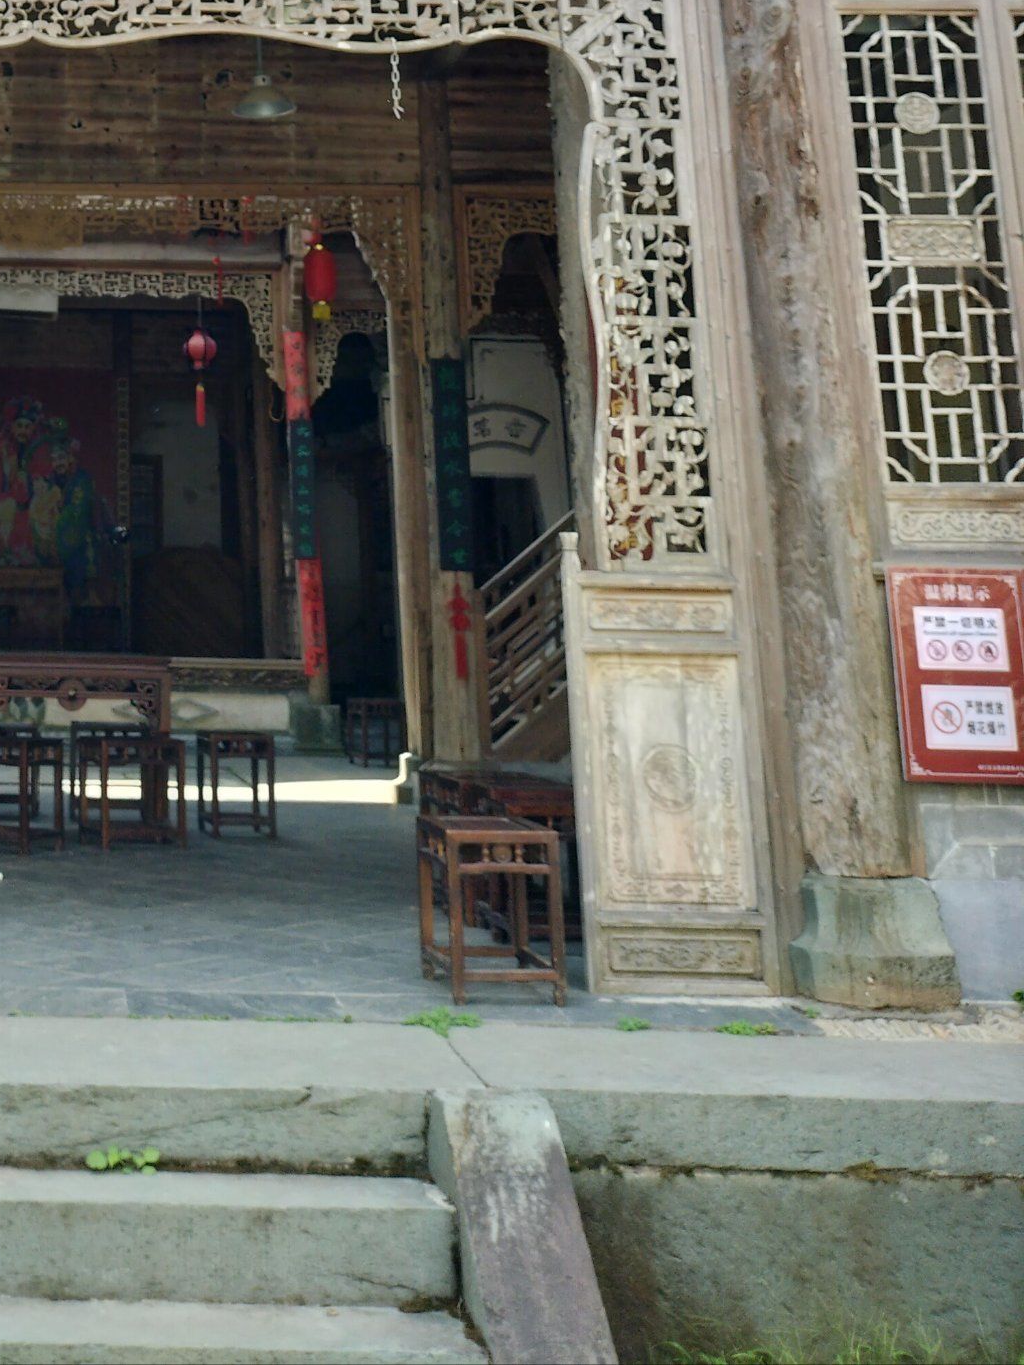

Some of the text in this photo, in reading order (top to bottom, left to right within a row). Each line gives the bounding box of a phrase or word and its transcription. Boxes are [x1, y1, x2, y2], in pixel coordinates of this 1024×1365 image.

[924, 583, 991, 602] 温馨提示
[964, 700, 1005, 715] 严禁燃放
[967, 721, 1007, 736] 烟花爆竹
